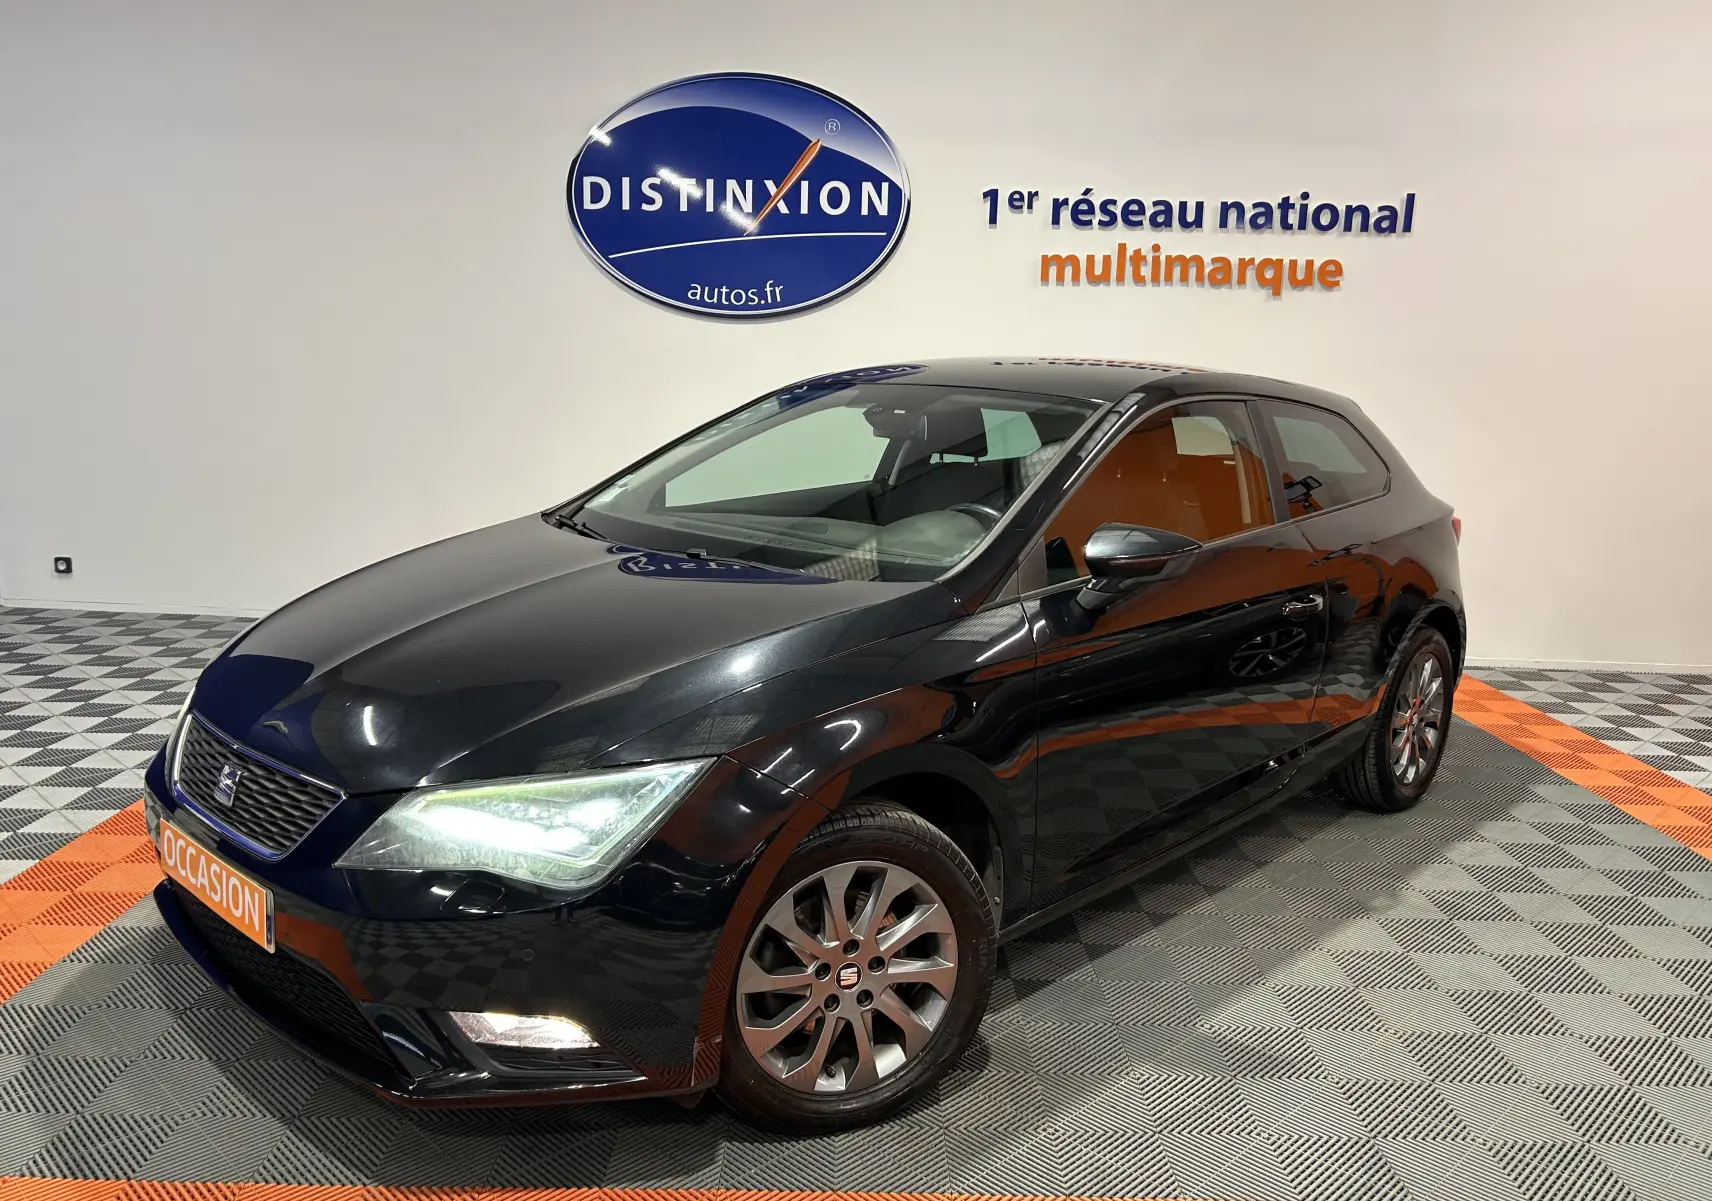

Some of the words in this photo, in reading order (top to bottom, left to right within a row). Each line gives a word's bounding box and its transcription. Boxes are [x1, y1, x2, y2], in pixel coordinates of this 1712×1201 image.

[582, 175, 890, 216] DISTINXION
[1051, 188, 1204, 228] réseau
[1219, 193, 1415, 233] national
[1040, 243, 1343, 296] multimarque
[687, 280, 784, 306] autos.fr
[163, 828, 260, 932] OCCASION
